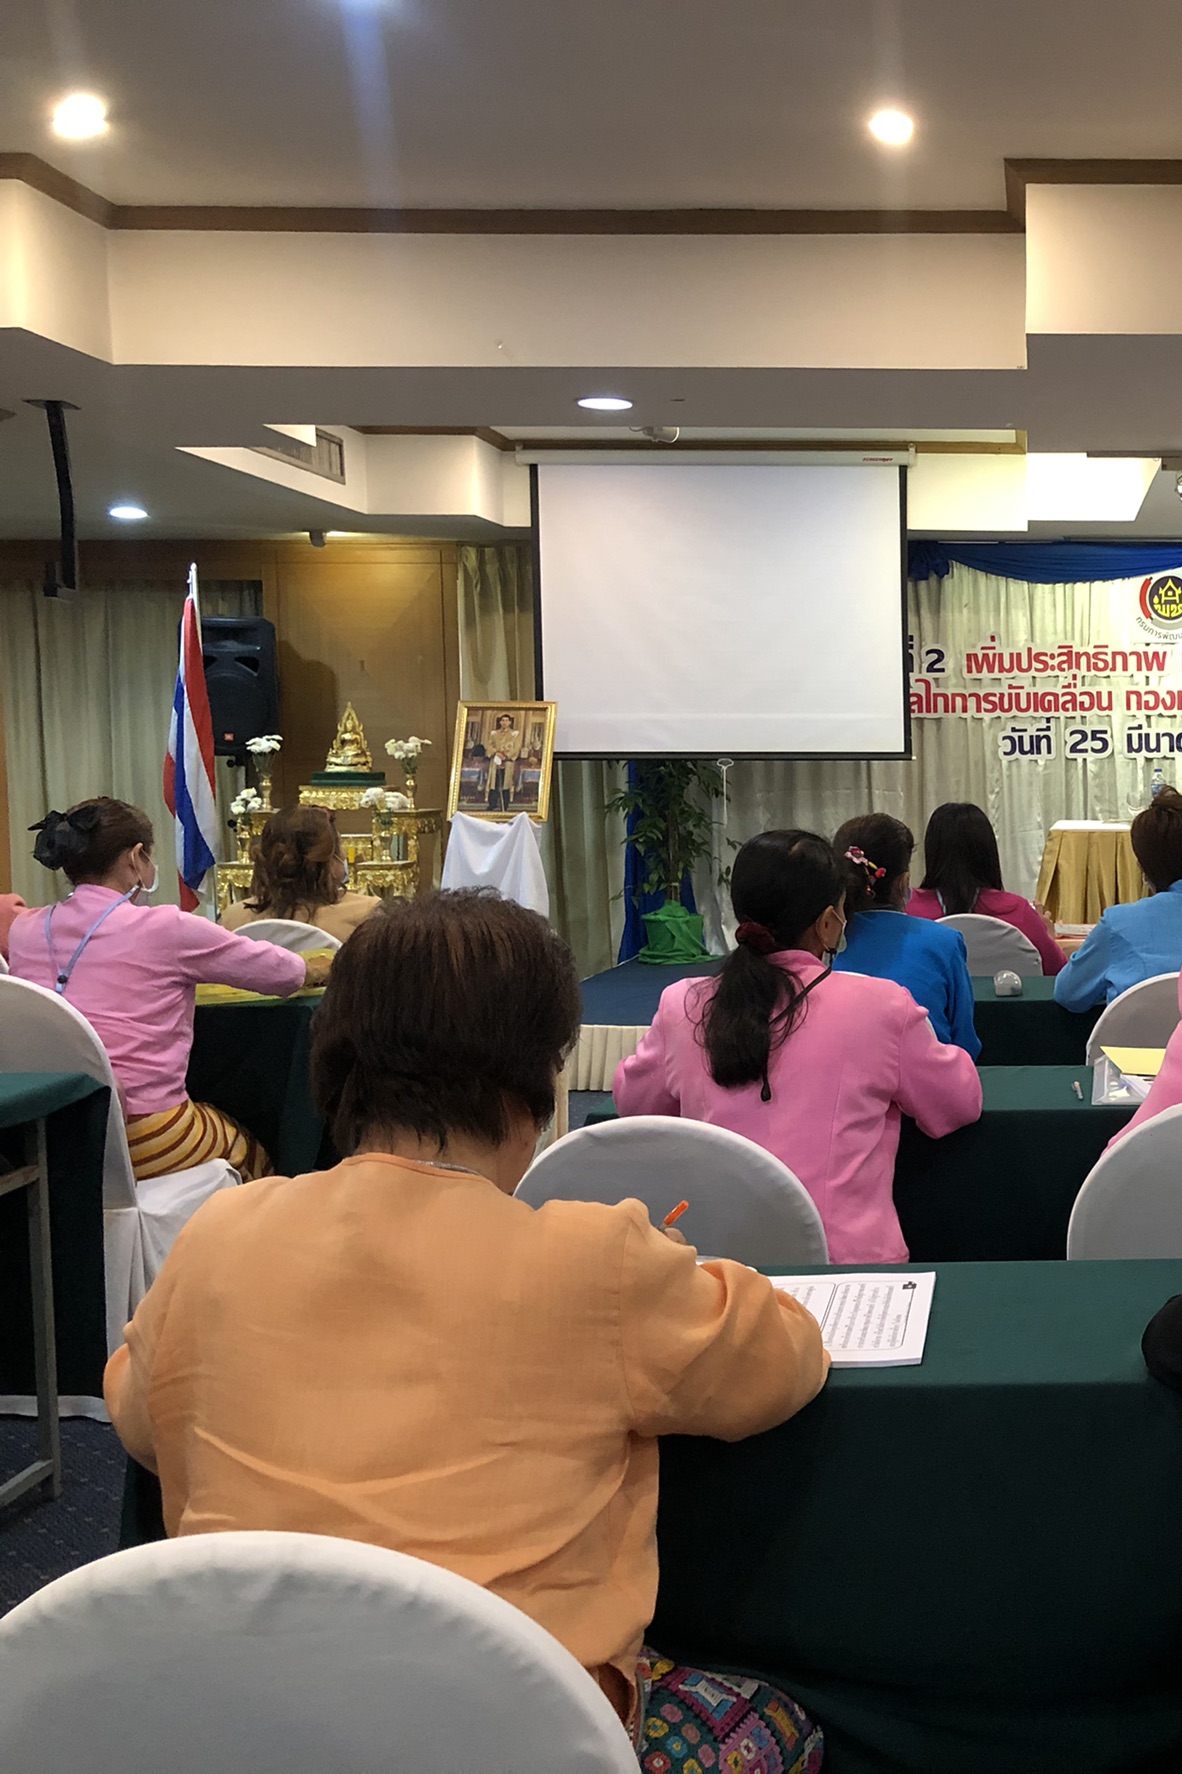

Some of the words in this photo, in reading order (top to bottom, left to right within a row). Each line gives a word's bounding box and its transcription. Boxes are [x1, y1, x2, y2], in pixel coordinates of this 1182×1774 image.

[924, 648, 946, 673] 2
[966, 635, 1167, 674] เพิ่มประสิทธิภาพ
[1001, 717, 1053, 756] วันที่
[1068, 729, 1110, 755] 25
